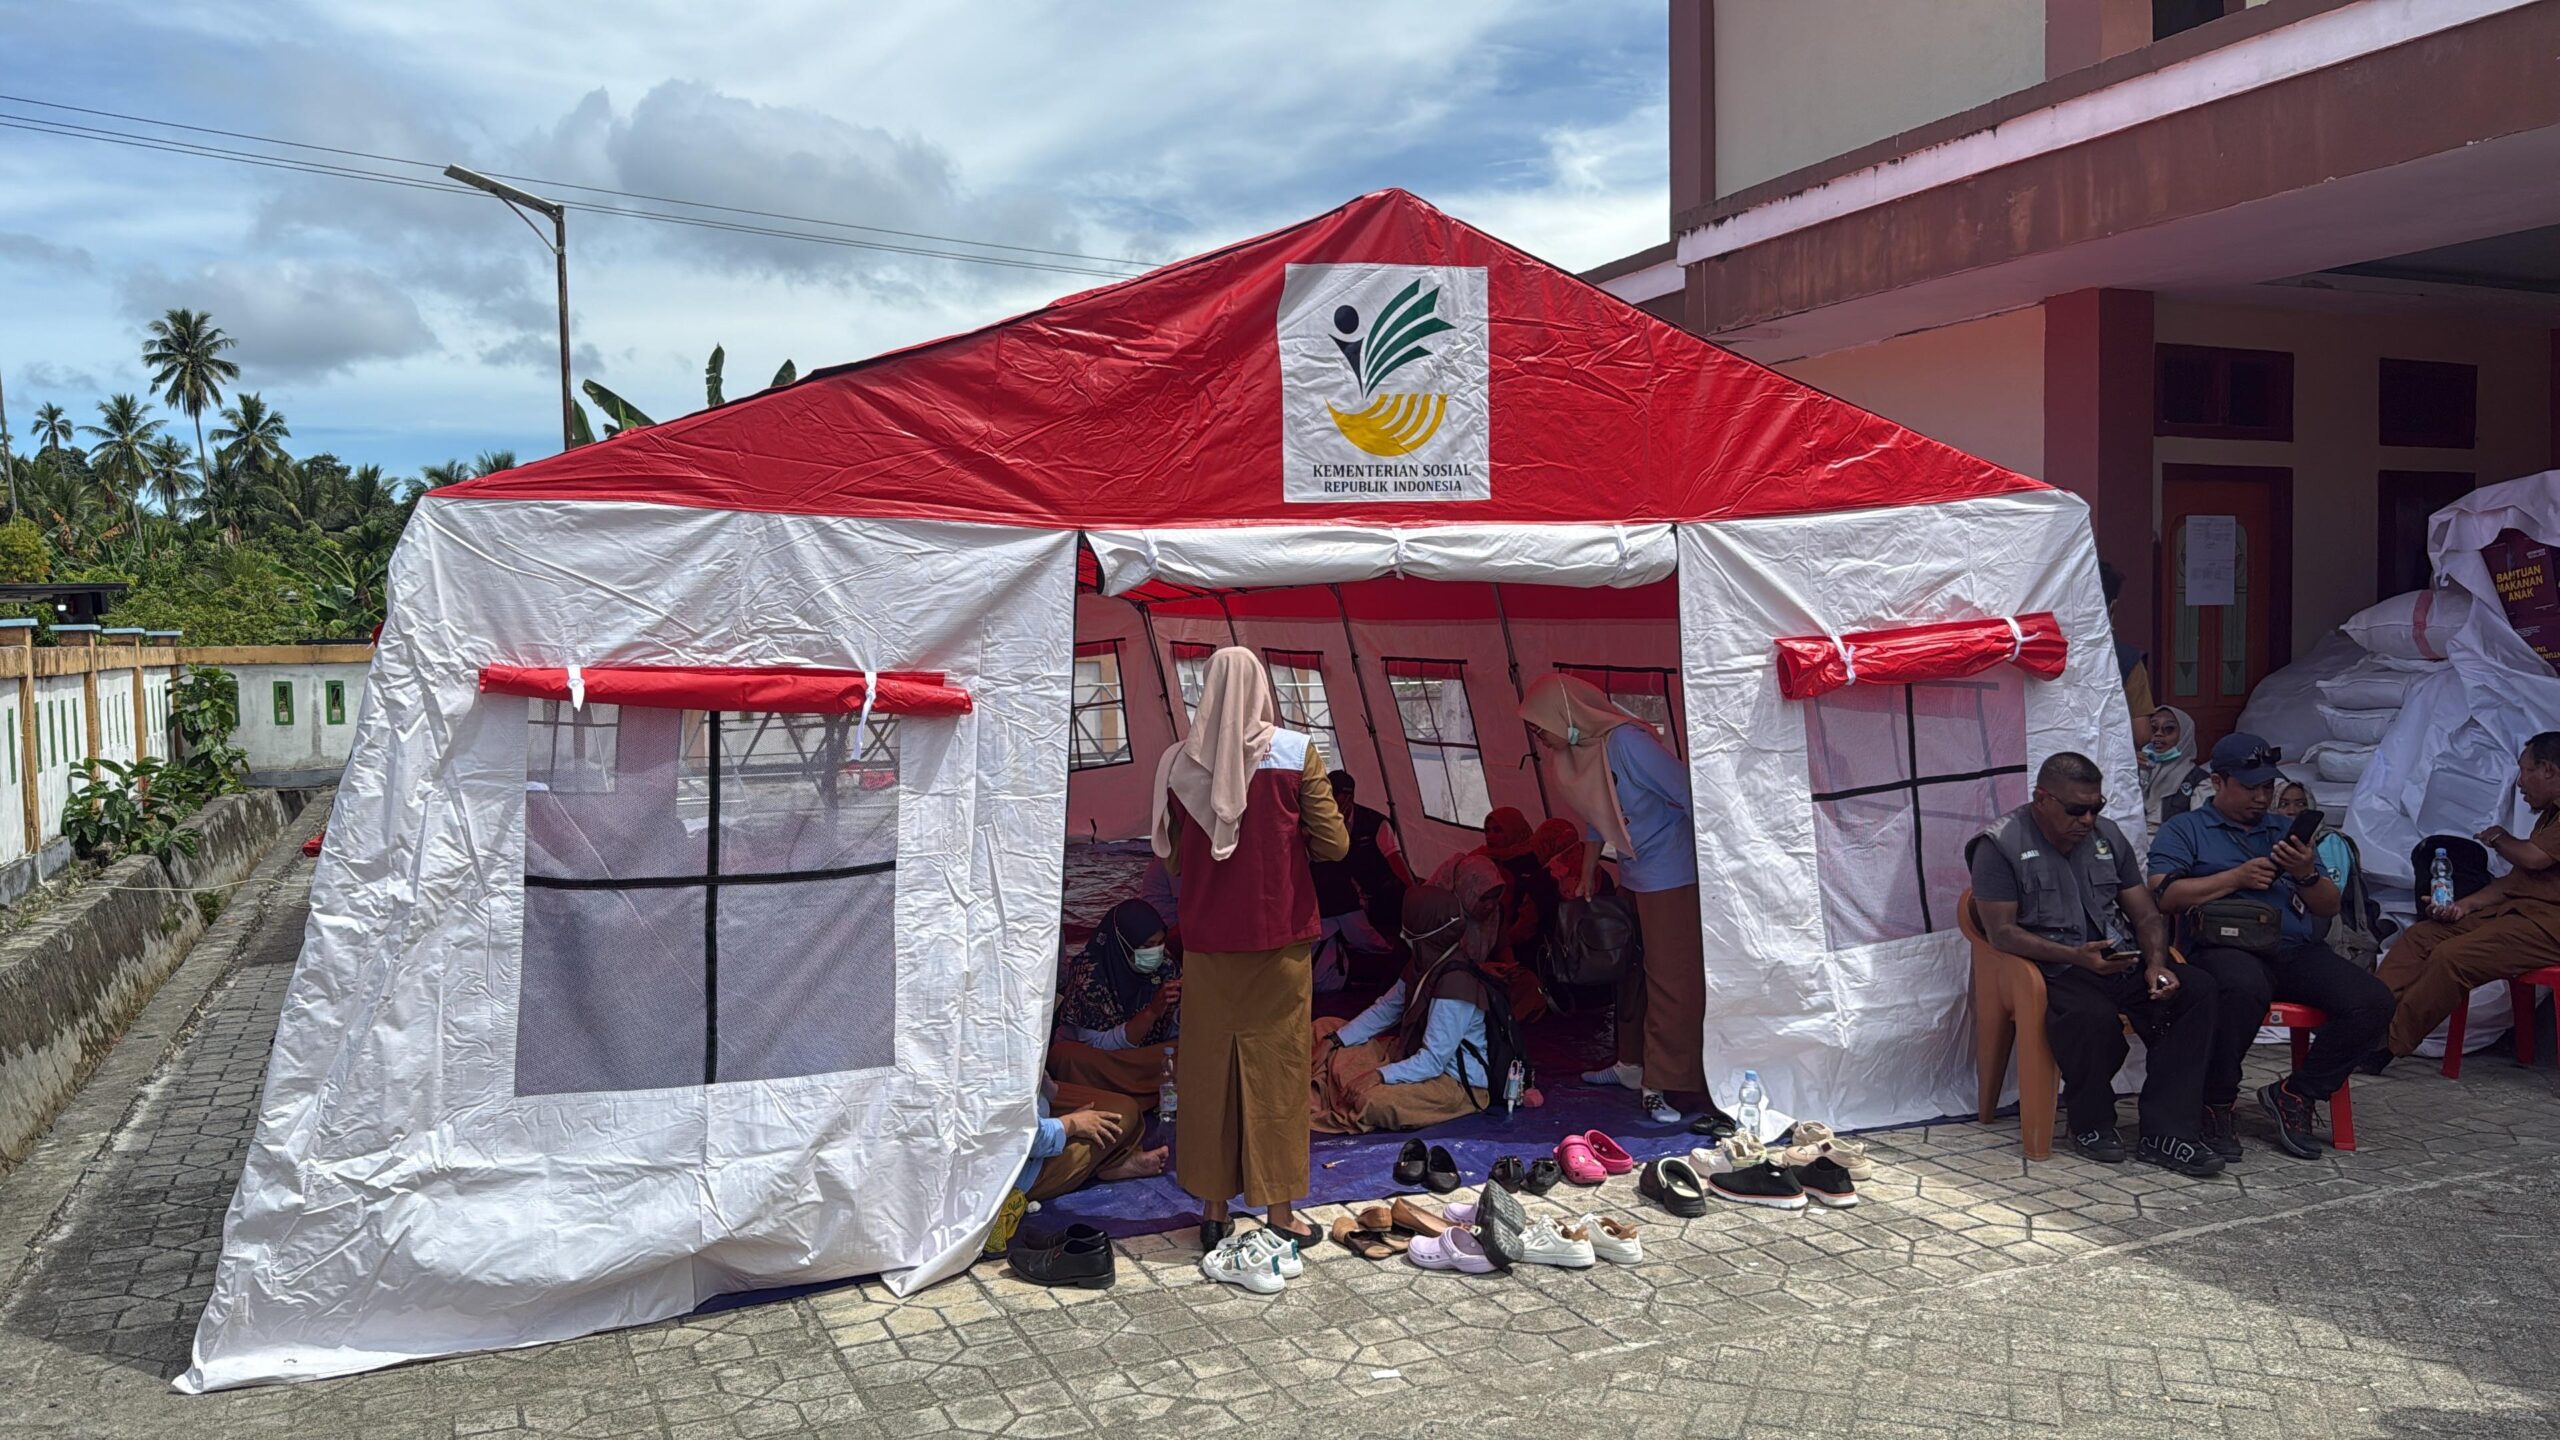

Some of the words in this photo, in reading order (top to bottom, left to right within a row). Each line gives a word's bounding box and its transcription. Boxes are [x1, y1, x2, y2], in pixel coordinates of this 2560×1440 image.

[1313, 464, 1418, 478] KEMENTERIAN
[1423, 463, 1472, 477] SOSIAL
[1324, 481, 1388, 493] REPUBLIK
[1394, 480, 1462, 492] INDONESIA
[2496, 564, 2541, 583] BANTUAN
[2497, 575, 2544, 593] MAKANAN
[2508, 588, 2535, 602] ANAK
